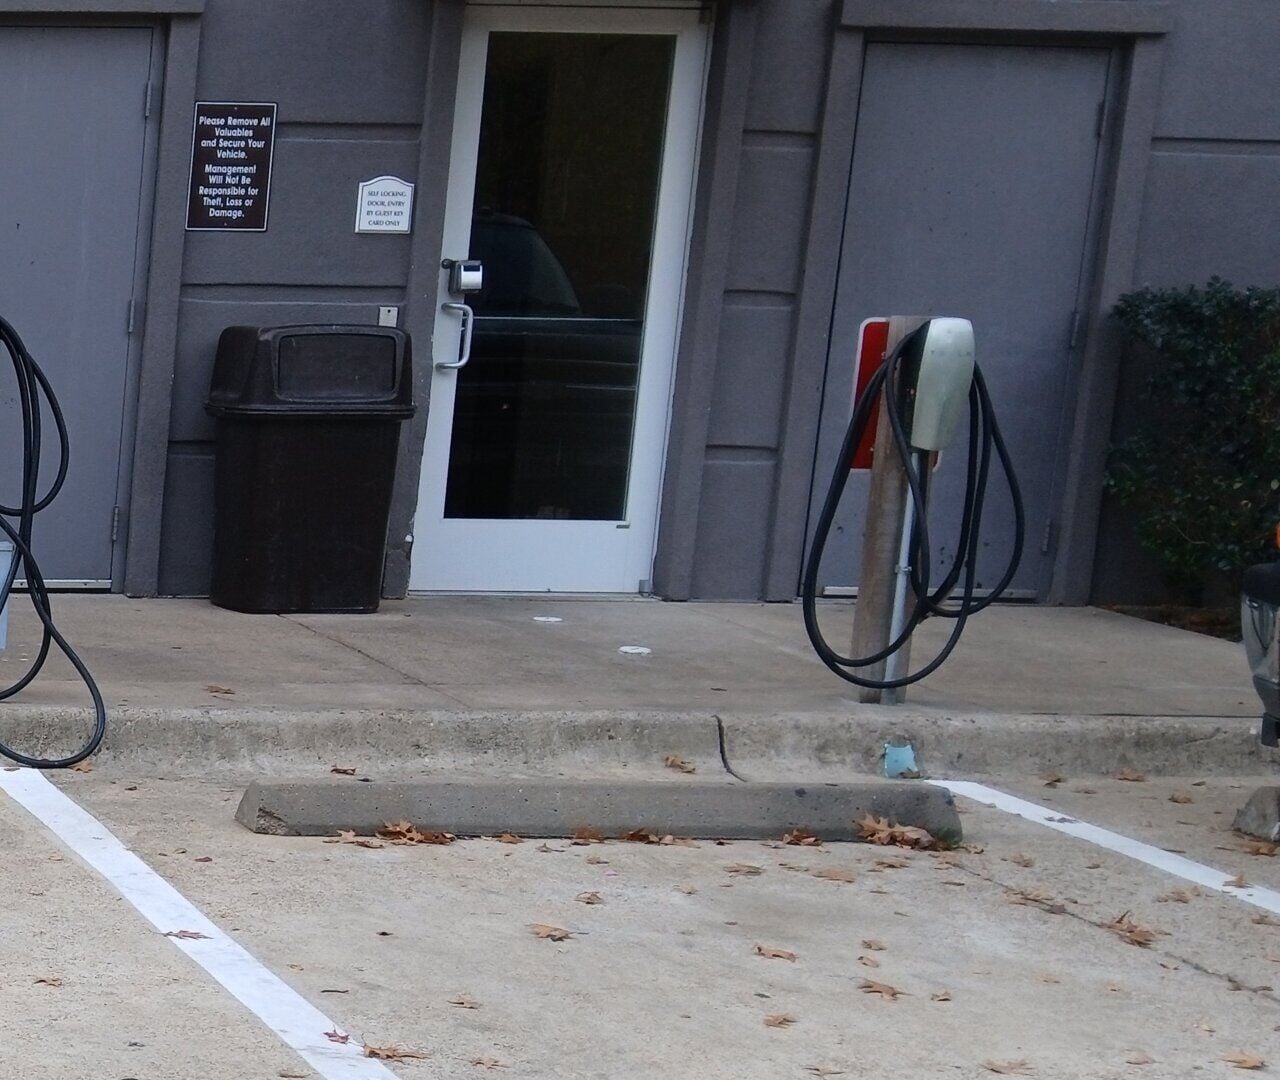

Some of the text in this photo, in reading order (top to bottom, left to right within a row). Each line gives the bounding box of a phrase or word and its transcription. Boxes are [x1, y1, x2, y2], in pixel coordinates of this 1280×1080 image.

[199, 116, 271, 126] Please Remove All
[215, 128, 253, 137] Valuables
[201, 139, 265, 148] and Secure Your
[217, 150, 248, 159] Vehicle.
[204, 164, 257, 175] Management
[209, 175, 252, 184] Will Not Be
[199, 186, 259, 196] Responsible for
[203, 197, 254, 208] Theft, Loss or
[209, 208, 245, 219] Damage.
